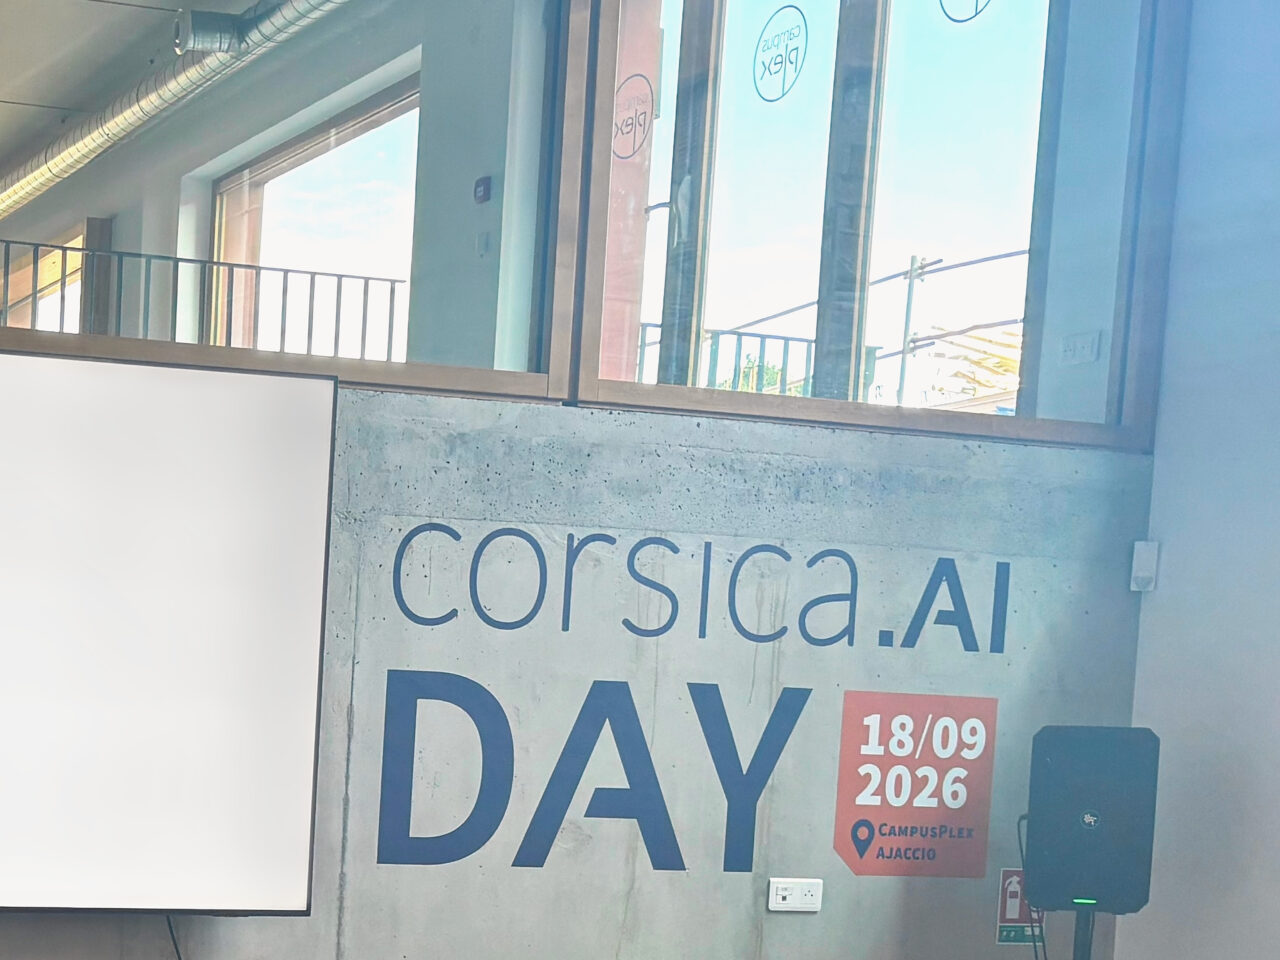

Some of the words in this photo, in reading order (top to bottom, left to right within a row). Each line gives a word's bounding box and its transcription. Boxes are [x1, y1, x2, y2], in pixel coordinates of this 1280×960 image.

[860, 713, 987, 760] 18/09
[376, 669, 813, 872] DAY
[854, 763, 969, 809] 2026
[876, 846, 936, 861] AJACCIO
